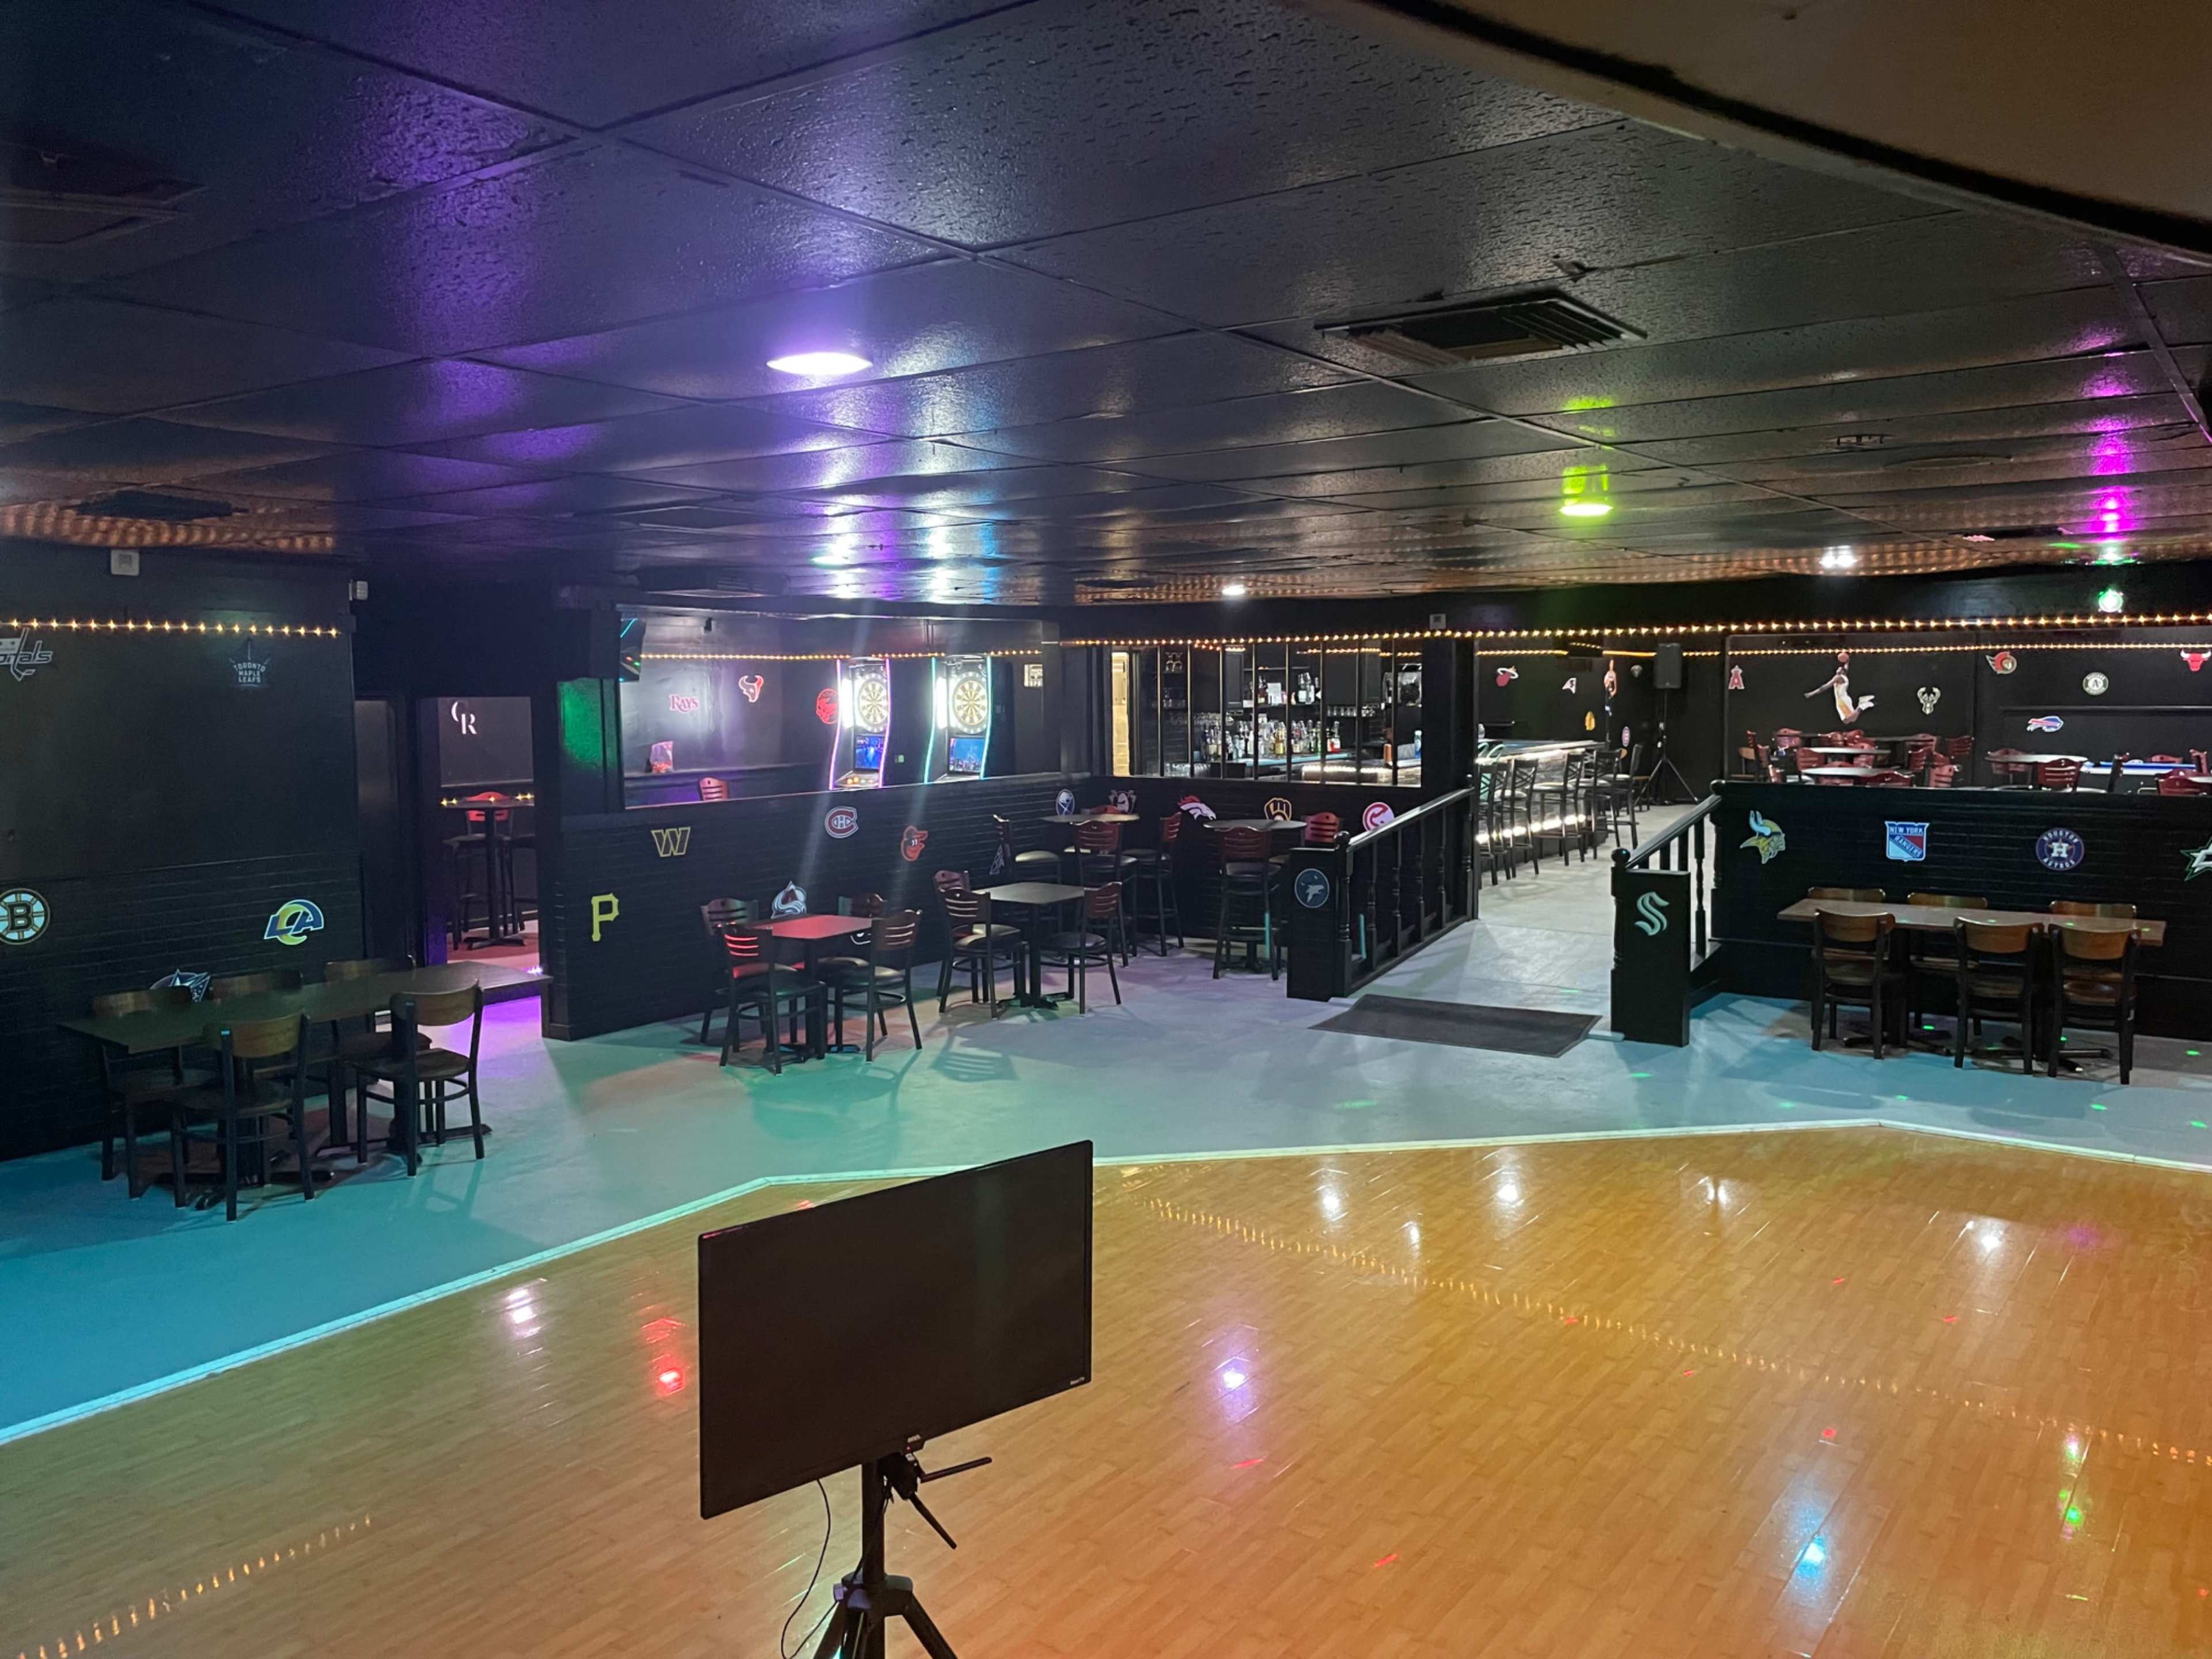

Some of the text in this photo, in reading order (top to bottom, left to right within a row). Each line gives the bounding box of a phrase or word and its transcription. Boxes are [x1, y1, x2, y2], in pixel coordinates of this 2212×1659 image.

[233, 662, 266, 673] TORONTO
[1889, 825, 1923, 835] NEW YORK
[2043, 830, 2078, 843] HOUSTON
[650, 826, 691, 857] W
[1894, 835, 1922, 857] RANGERS
[2051, 842, 2069, 858] H
[2043, 858, 2075, 869] ASTROS
[591, 892, 619, 942] P
